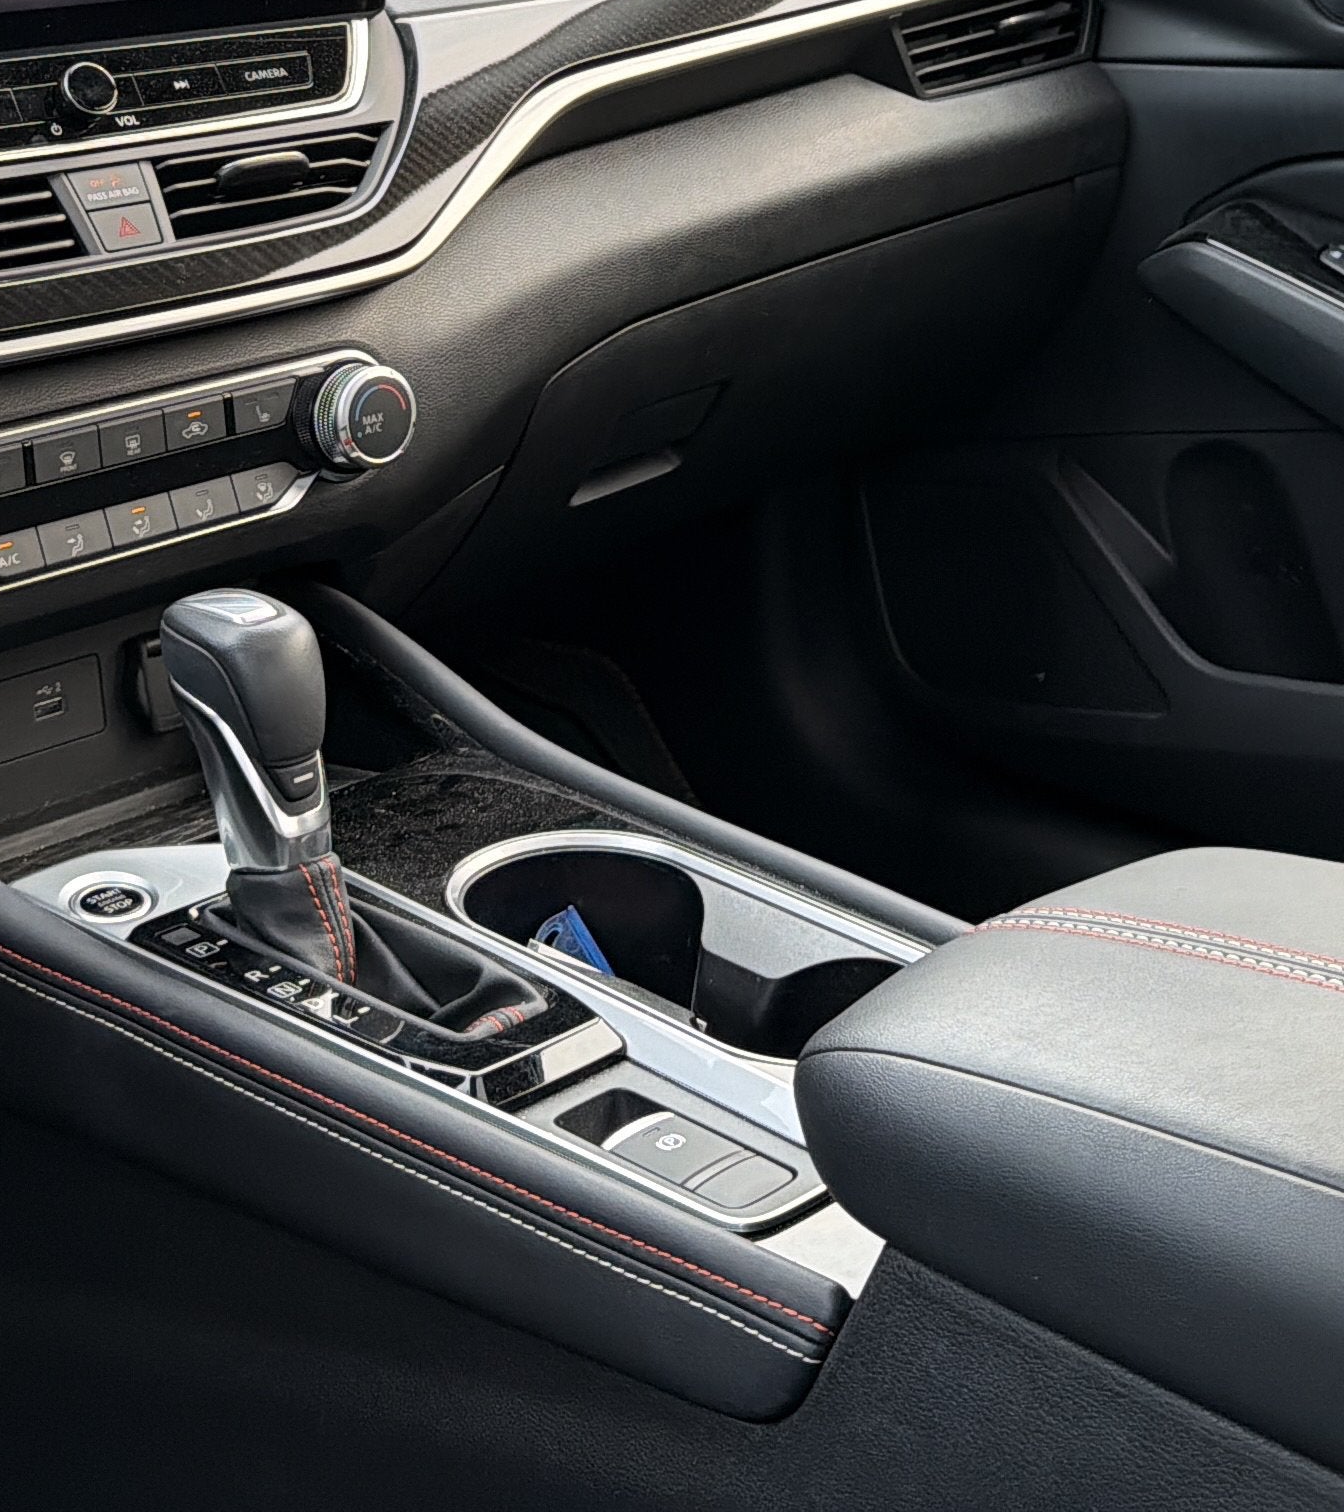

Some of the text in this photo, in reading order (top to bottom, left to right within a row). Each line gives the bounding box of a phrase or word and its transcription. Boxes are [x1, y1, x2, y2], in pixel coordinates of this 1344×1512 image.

[244, 67, 289, 82] CAMERA
[115, 115, 140, 128] VOL
[87, 186, 140, 202] PASS AIR BAG
[362, 412, 385, 425] MAX
[364, 423, 384, 436] A/C
[86, 888, 122, 905] START
[103, 898, 134, 914] STOP
[244, 969, 270, 984] R
